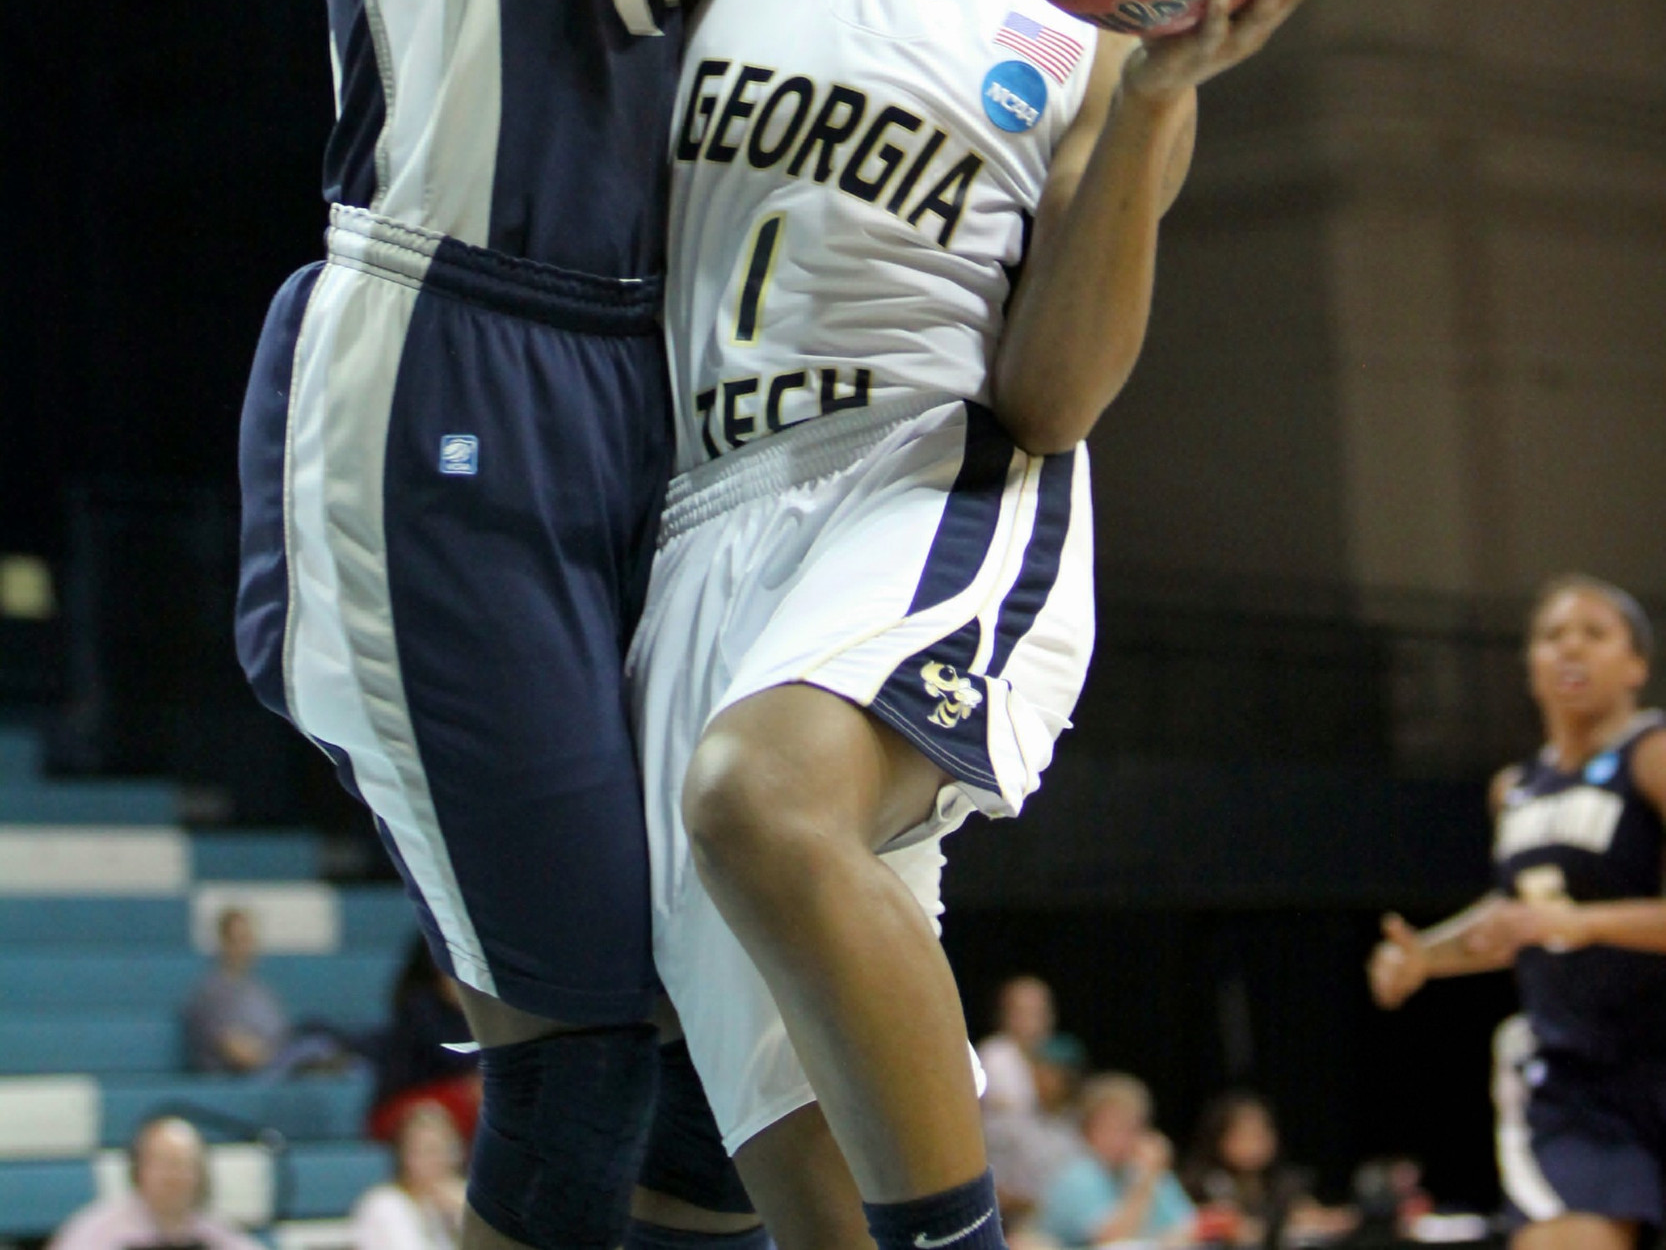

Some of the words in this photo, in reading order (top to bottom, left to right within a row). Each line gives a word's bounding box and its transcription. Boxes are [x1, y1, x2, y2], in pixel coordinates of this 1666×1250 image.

[675, 58, 985, 249] GEORGIA
[984, 81, 1040, 127] NCAA
[728, 209, 788, 348] 1
[694, 367, 875, 459] TECH
